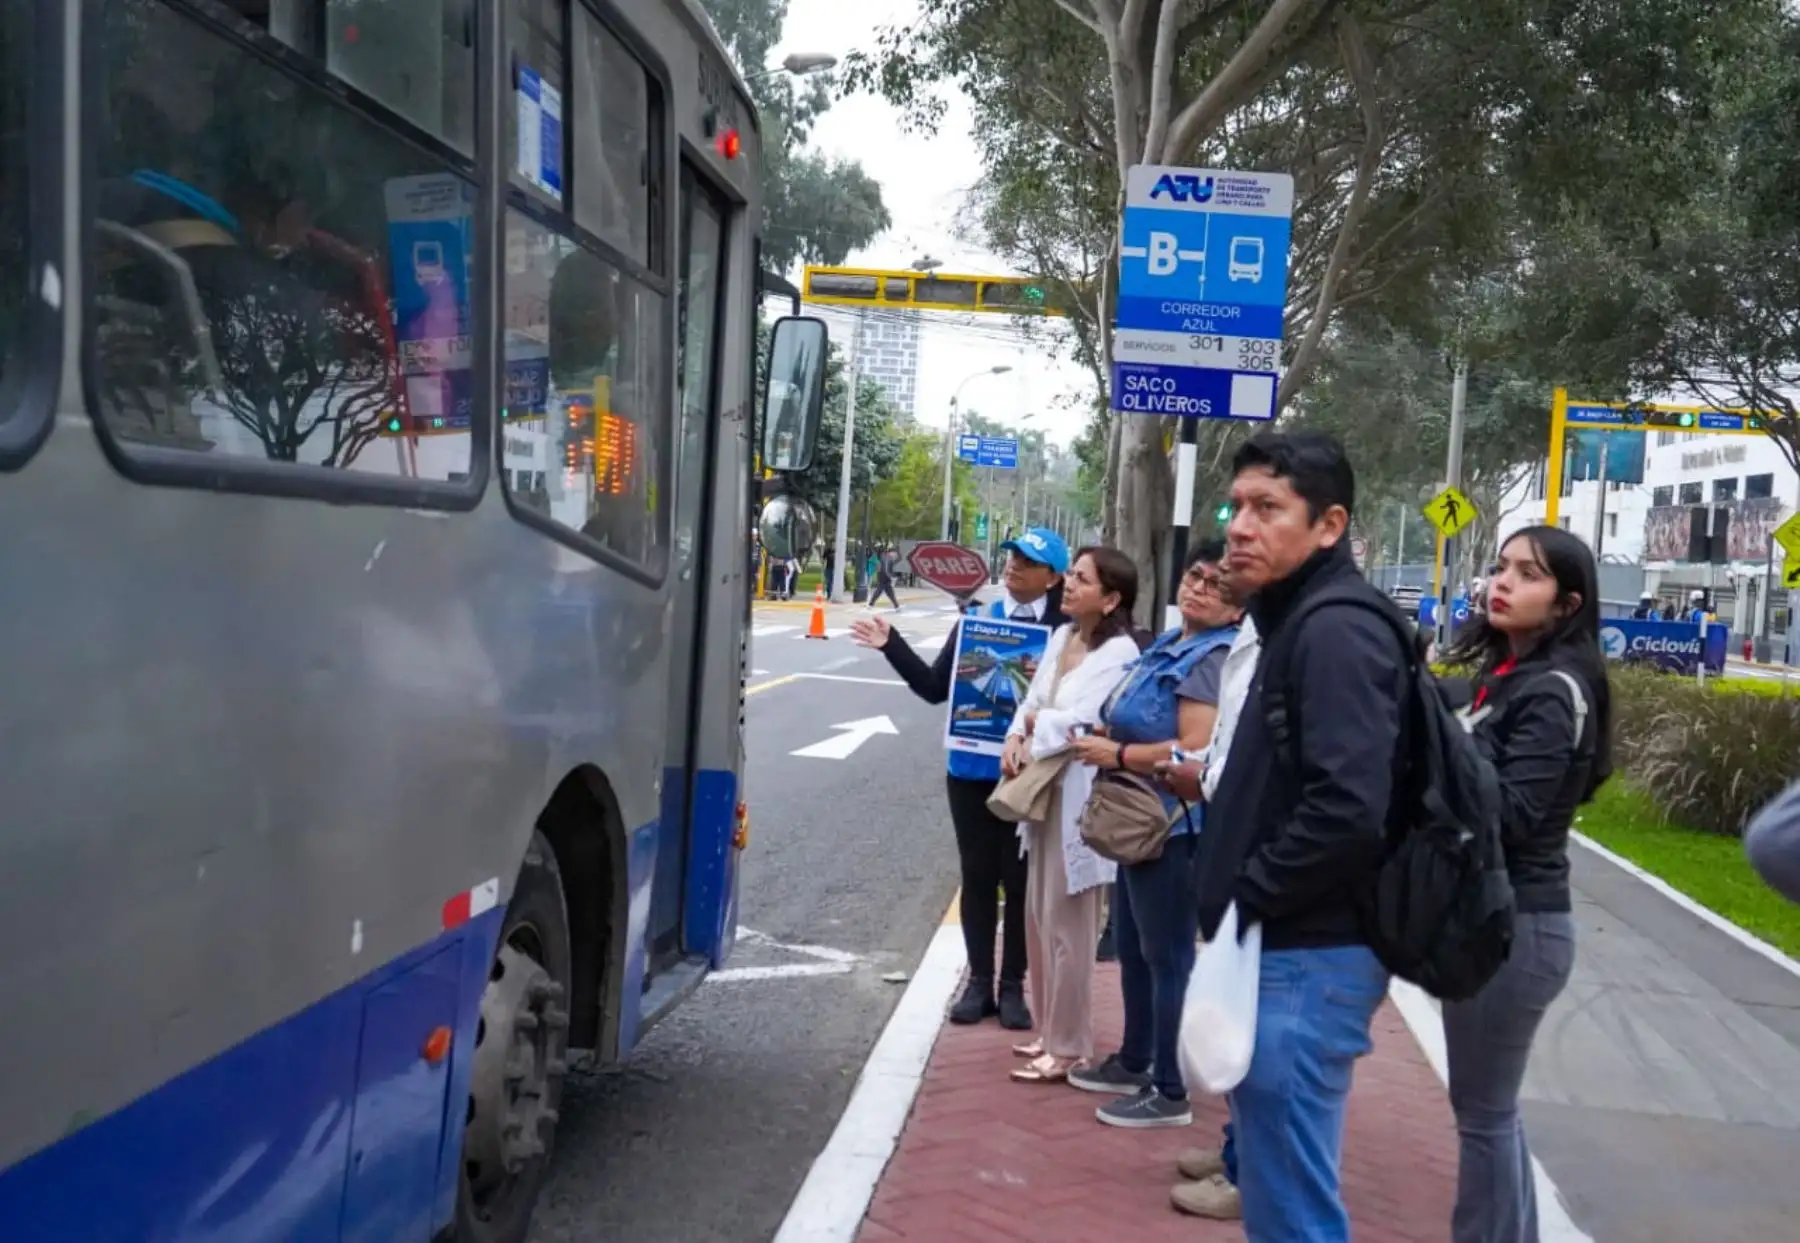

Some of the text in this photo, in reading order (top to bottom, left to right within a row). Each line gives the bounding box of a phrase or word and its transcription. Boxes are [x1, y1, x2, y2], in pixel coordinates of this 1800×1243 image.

[1149, 173, 1214, 203] ATU
[1161, 302, 1241, 319] CORREDOR
[1182, 318, 1219, 332] AZUL
[1188, 335, 1224, 352] 301
[1238, 338, 1276, 355] 303
[1237, 354, 1274, 370] 305
[1124, 375, 1177, 393] SACO
[1122, 393, 1212, 414] OLIVEROS
[918, 556, 980, 576] PARE
